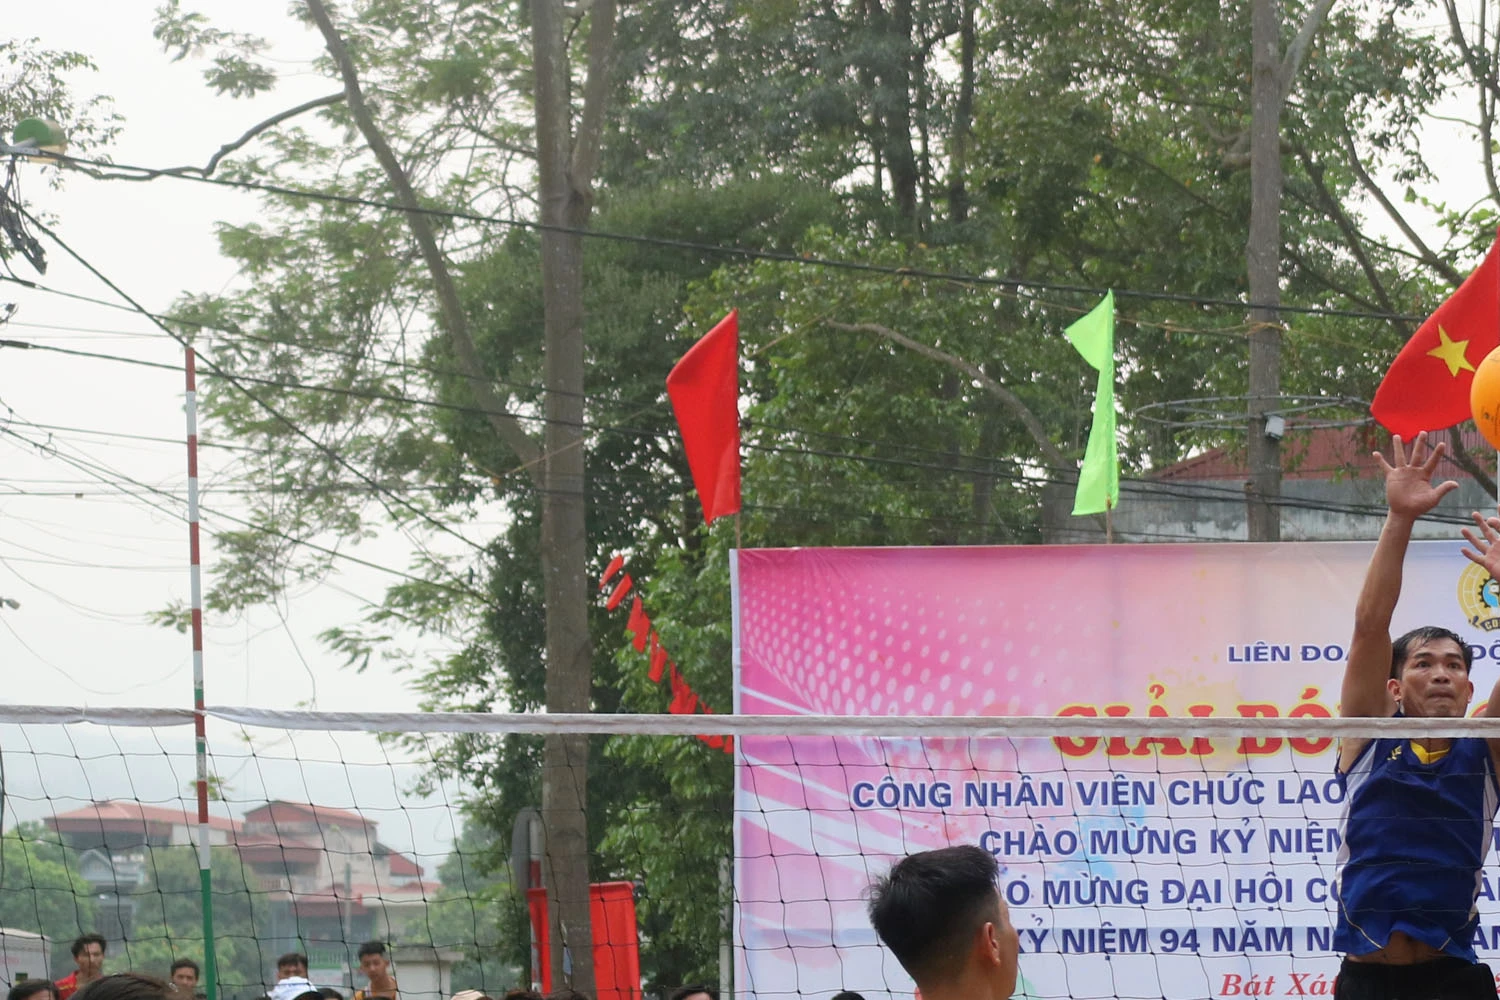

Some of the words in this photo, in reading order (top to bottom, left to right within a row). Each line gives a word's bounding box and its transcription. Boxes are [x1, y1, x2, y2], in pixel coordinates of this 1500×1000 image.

[1229, 641, 1290, 662] LIÊN
[1300, 645, 1344, 661] ĐO
[1054, 684, 1214, 756] GIẢI
[853, 776, 951, 807] CÔNG
[965, 776, 1063, 807] NHÂN
[1077, 775, 1155, 806] VIÊN
[1168, 773, 1264, 805] CHỨC
[1278, 779, 1344, 804] LAO
[980, 824, 1077, 856] CHÀO
[1090, 823, 1196, 856] MỪNG
[1210, 817, 1256, 854] KỶ
[1043, 872, 1148, 905] MỪNG
[1160, 879, 1221, 912] ĐẠI
[1235, 872, 1293, 912] HỘI
[1062, 922, 1148, 960] NIỆM
[1159, 928, 1201, 953] 94
[1212, 920, 1293, 952] NĂM
[1219, 973, 1275, 996] Bát
